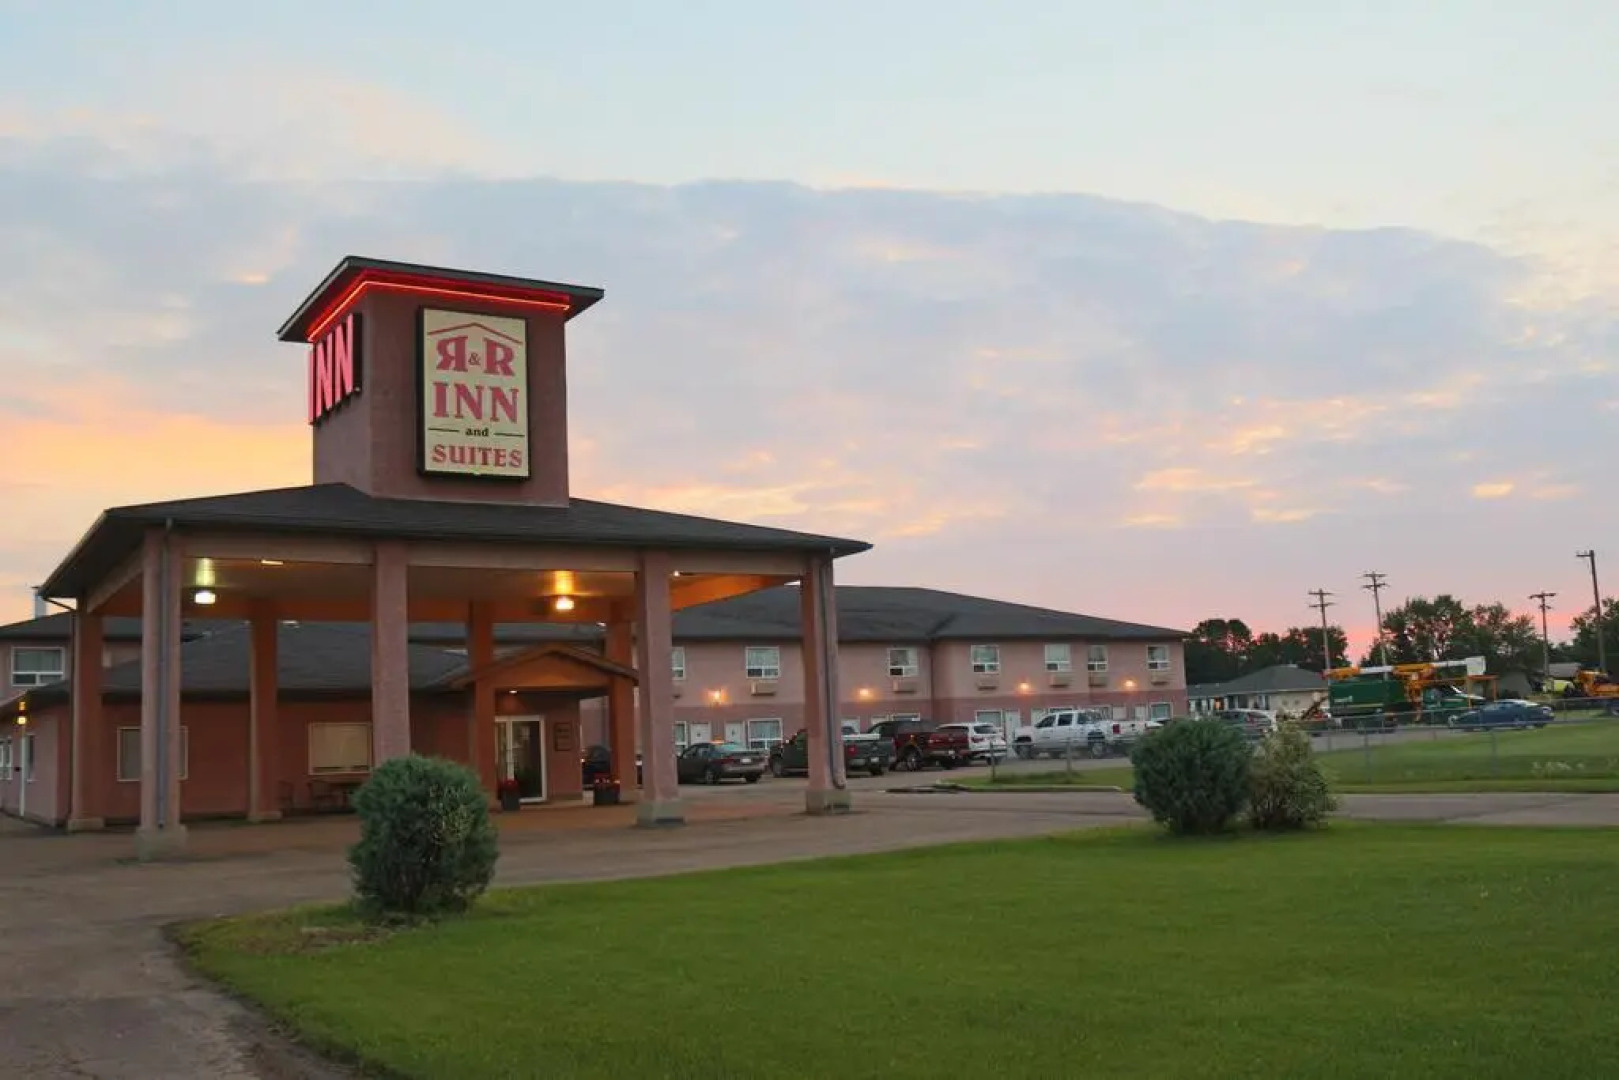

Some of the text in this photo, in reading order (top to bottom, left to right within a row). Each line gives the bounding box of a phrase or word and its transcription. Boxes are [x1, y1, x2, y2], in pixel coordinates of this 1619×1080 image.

[308, 312, 354, 422] INN
[433, 381, 520, 424] INN
[465, 426, 490, 438] and
[431, 443, 523, 469] SUITES
